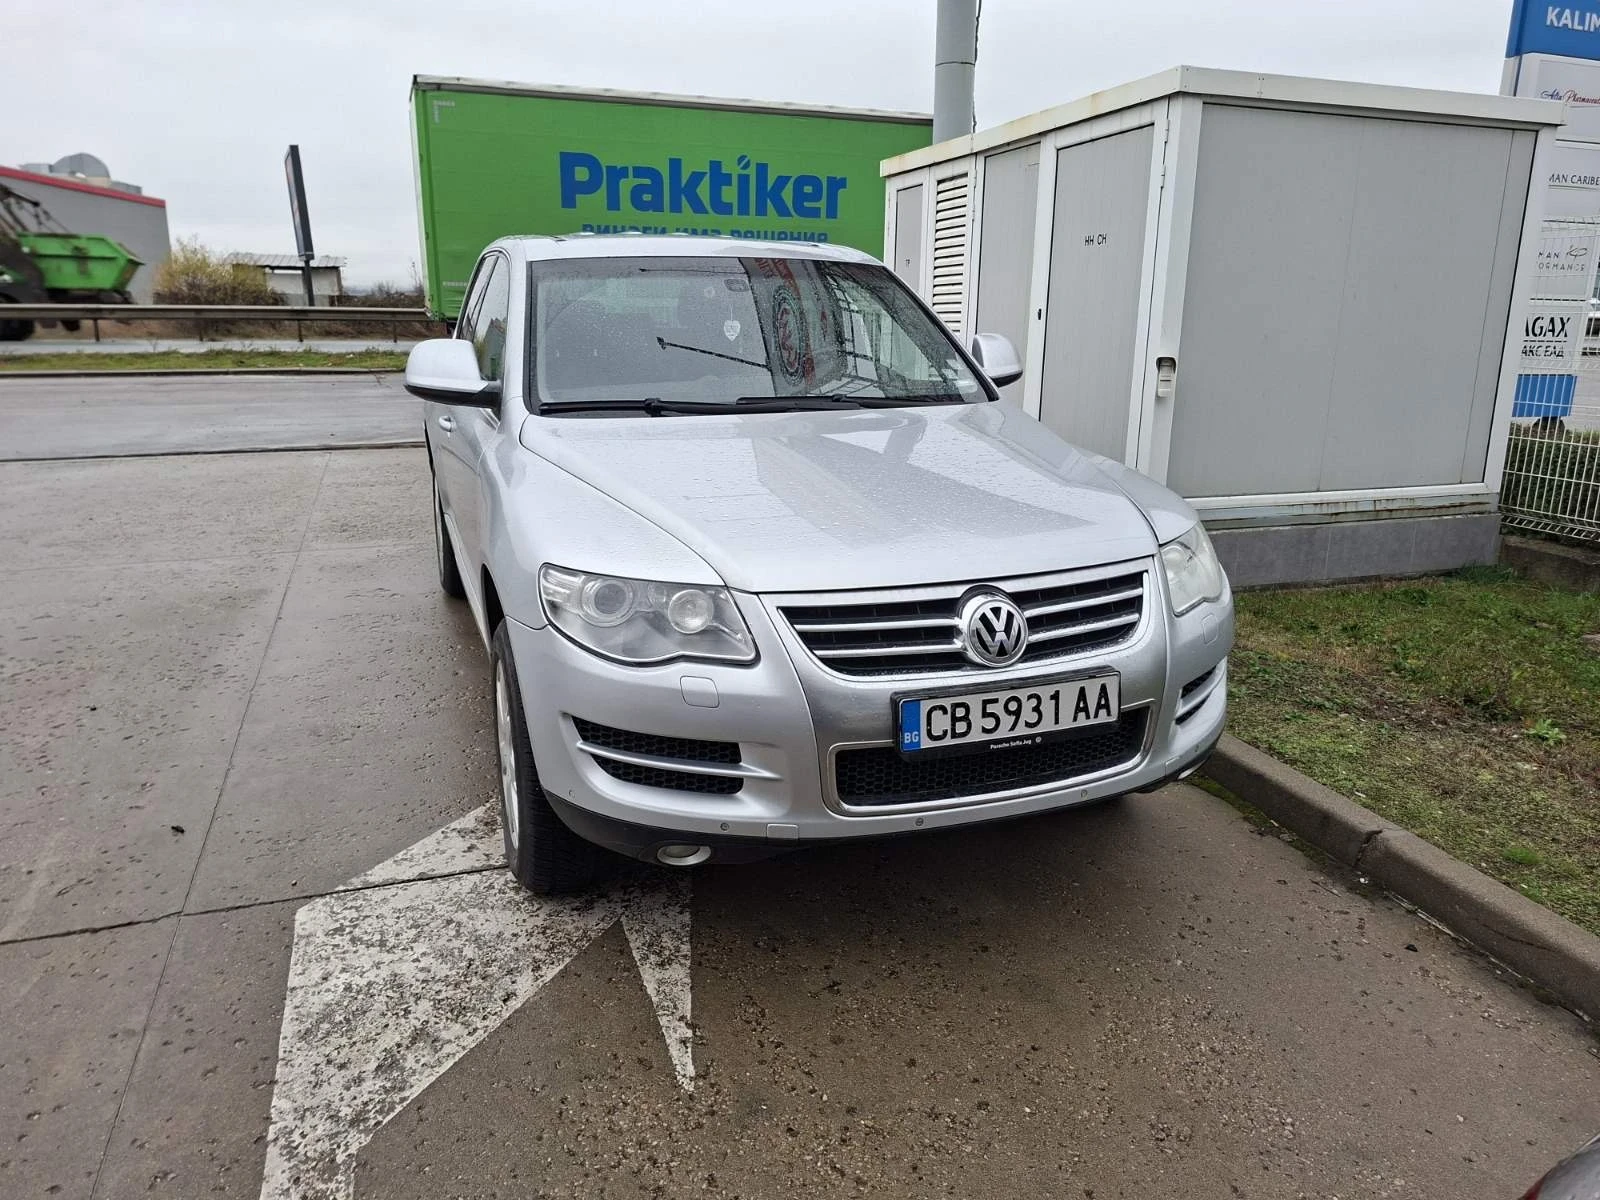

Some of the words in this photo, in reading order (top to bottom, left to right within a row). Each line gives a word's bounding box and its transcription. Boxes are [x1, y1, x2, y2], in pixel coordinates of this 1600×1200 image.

[1545, 6, 1600, 32] KALIM
[559, 151, 847, 219] Praktiker
[904, 731, 920, 743] BG
